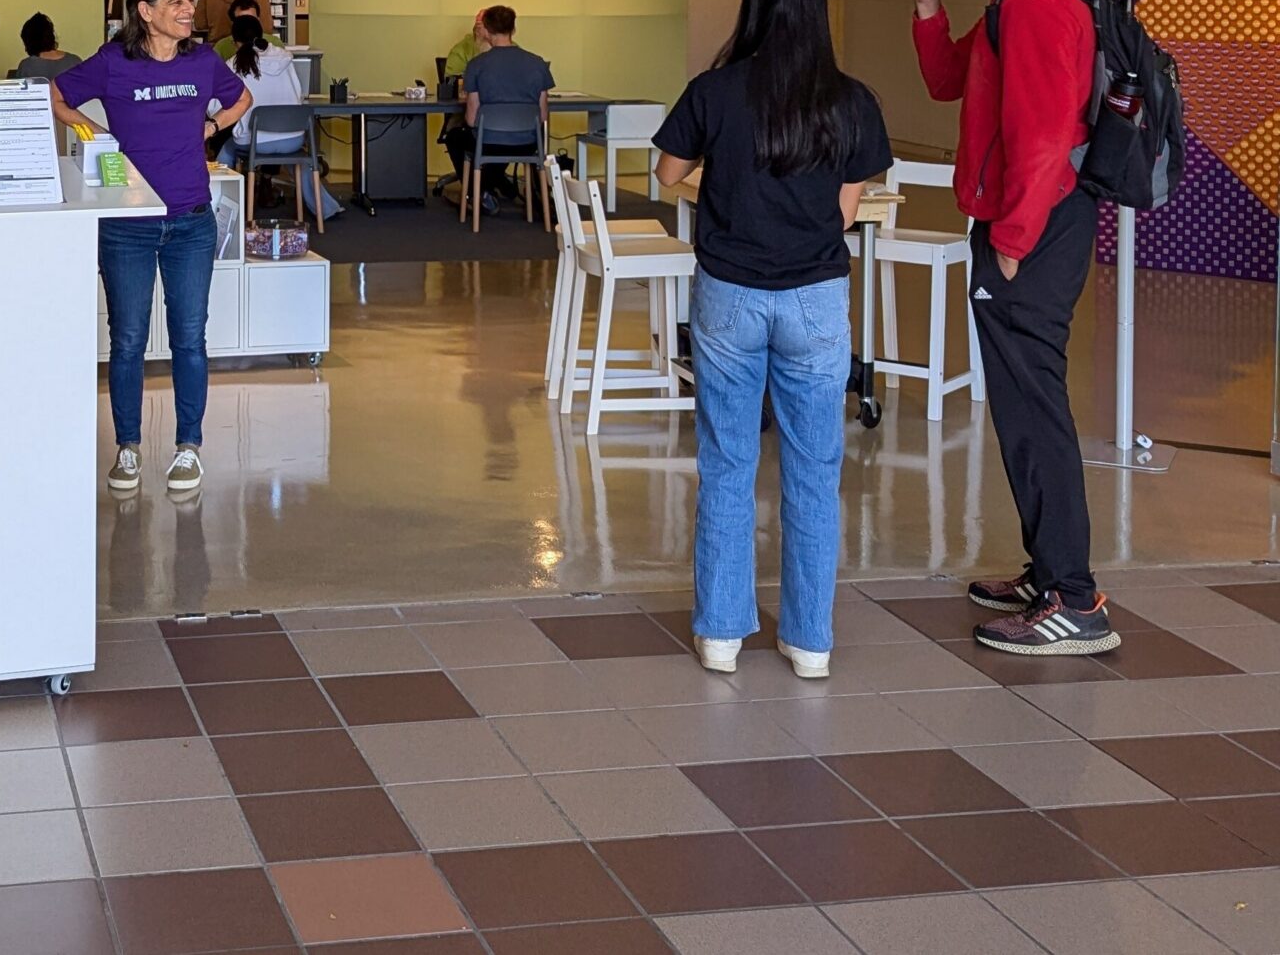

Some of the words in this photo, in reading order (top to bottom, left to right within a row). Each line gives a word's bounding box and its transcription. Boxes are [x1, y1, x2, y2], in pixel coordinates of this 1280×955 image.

[134, 87, 151, 101] M
[155, 86, 177, 99] UMICH
[177, 85, 198, 97] VOTES
